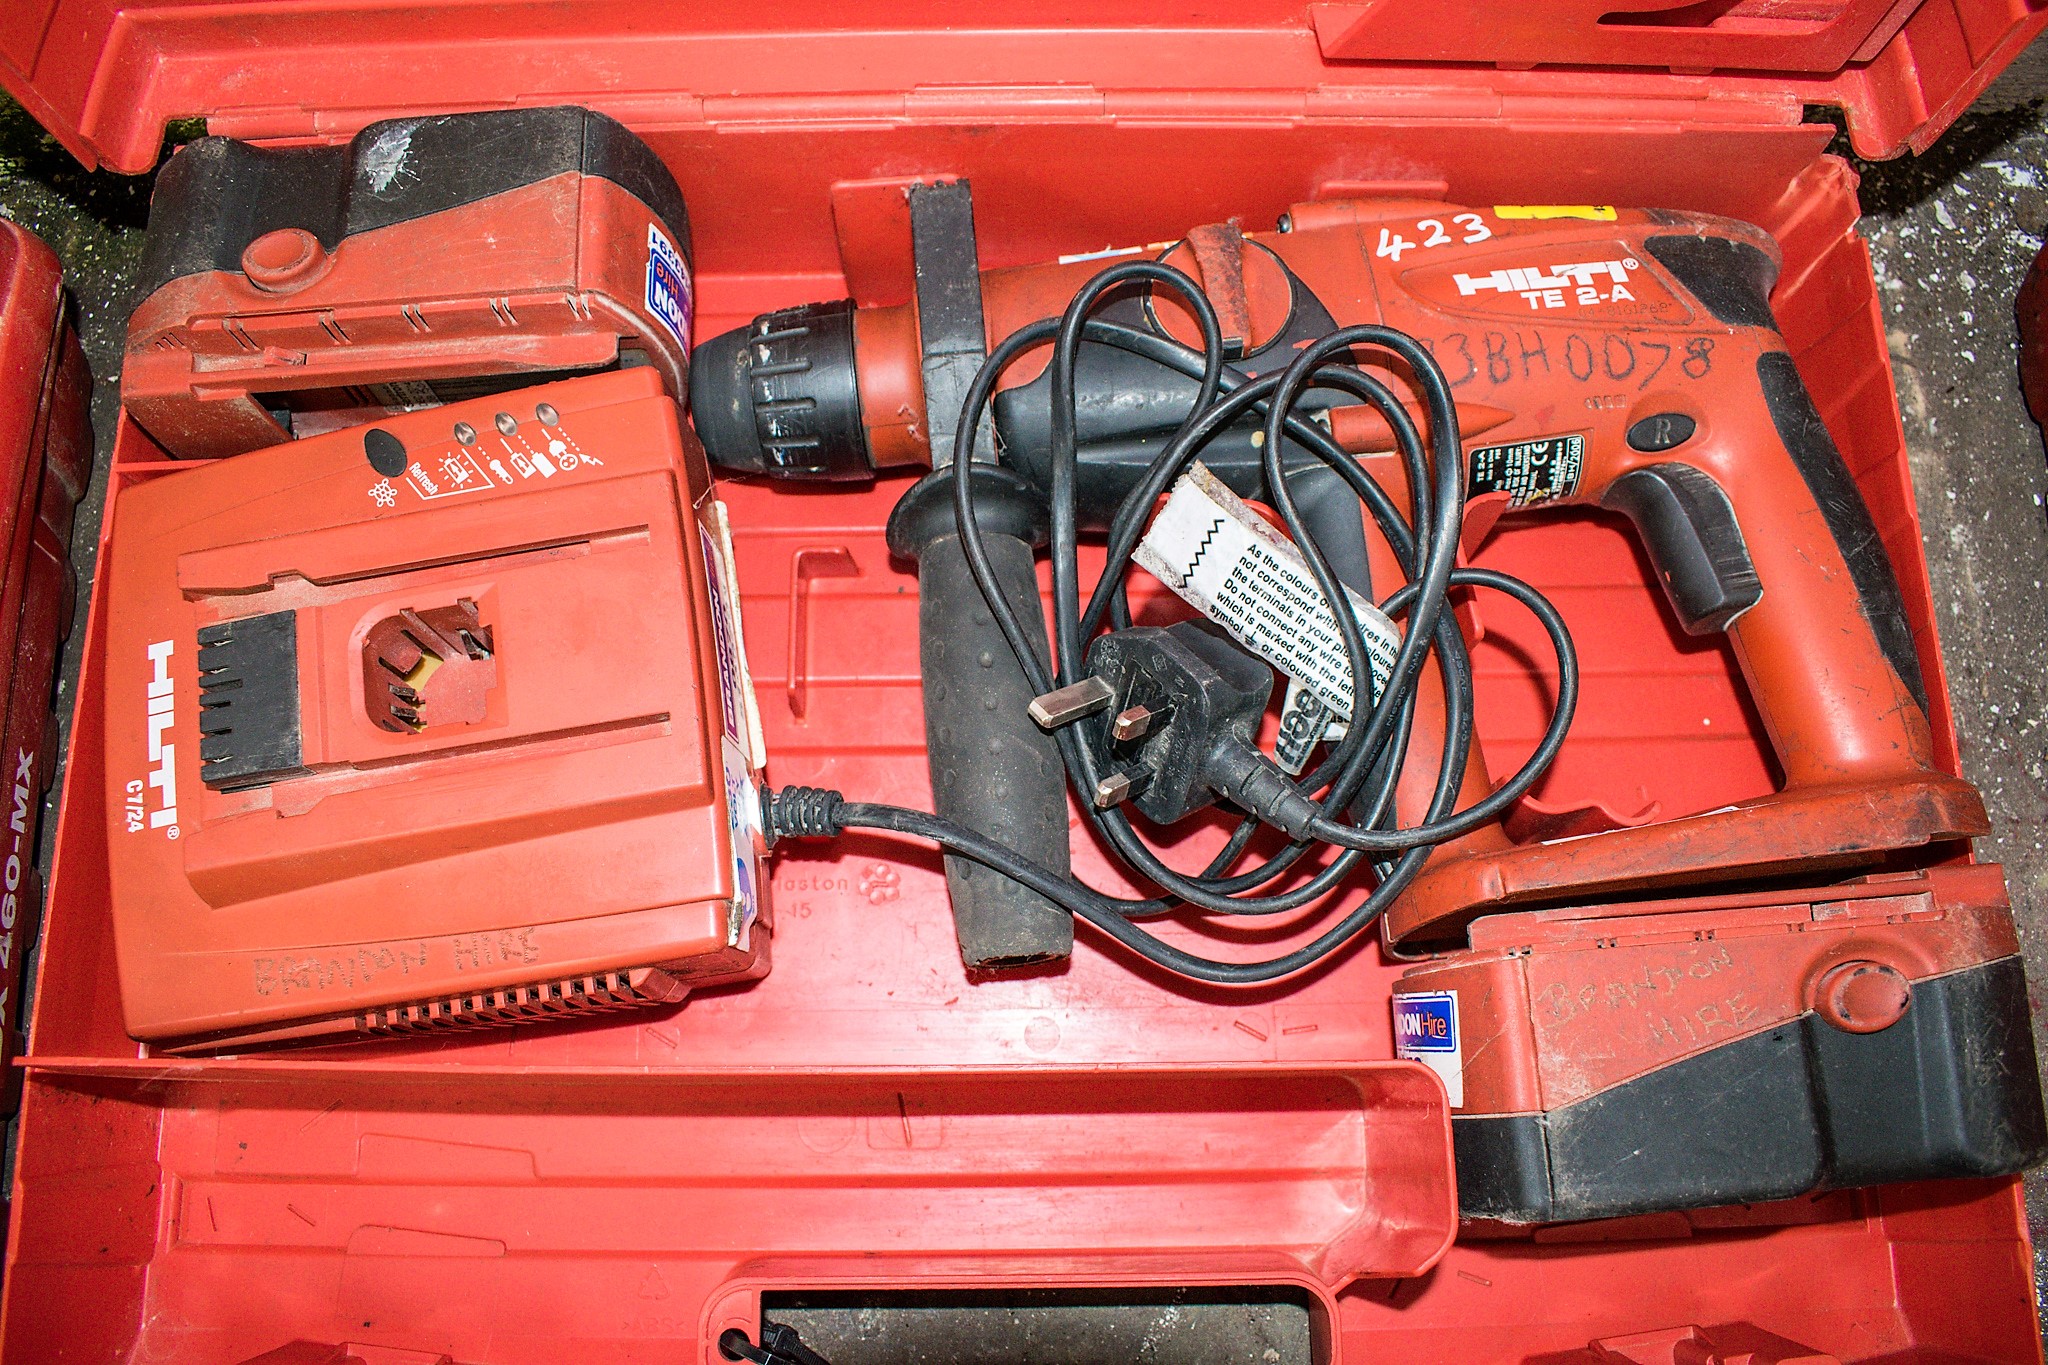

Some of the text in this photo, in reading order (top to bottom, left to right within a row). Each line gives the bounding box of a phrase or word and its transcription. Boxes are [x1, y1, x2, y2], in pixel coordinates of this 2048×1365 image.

[1376, 213, 1493, 261] 423
[657, 261, 679, 300] Hire
[1453, 260, 1629, 296] HILTI
[1520, 284, 1636, 310] TE 2-A
[1654, 418, 1671, 444] R
[408, 462, 438, 495] Refresh
[1231, 567, 1352, 661] the terminals in your plu
[1239, 556, 1256, 572] not
[1256, 570, 1313, 614] correspond
[1315, 612, 1337, 631] with
[1247, 543, 1261, 557] As
[1263, 555, 1280, 570] the
[1280, 568, 1318, 599] colours
[1357, 622, 1379, 642] ires
[1380, 639, 1390, 651] in
[1207, 603, 1244, 634] symbol
[1261, 643, 1273, 655] or
[1274, 651, 1320, 689] coloured
[1319, 686, 1349, 710] green
[1214, 591, 1245, 617] which
[1245, 612, 1256, 625] is
[1256, 622, 1294, 653] marked
[1295, 649, 1317, 669] with
[1318, 666, 1337, 683] the
[1223, 579, 1238, 594] Do
[1238, 591, 1256, 607] not
[1256, 604, 1297, 637] connect
[1296, 635, 1317, 654] any
[1318, 648, 1342, 669] wire
[1342, 666, 1354, 678] to
[147, 639, 178, 829] HILTI
[124, 779, 145, 833] C7/24
[0, 747, 34, 969] 460-MX
[1421, 1011, 1447, 1037] Hire
